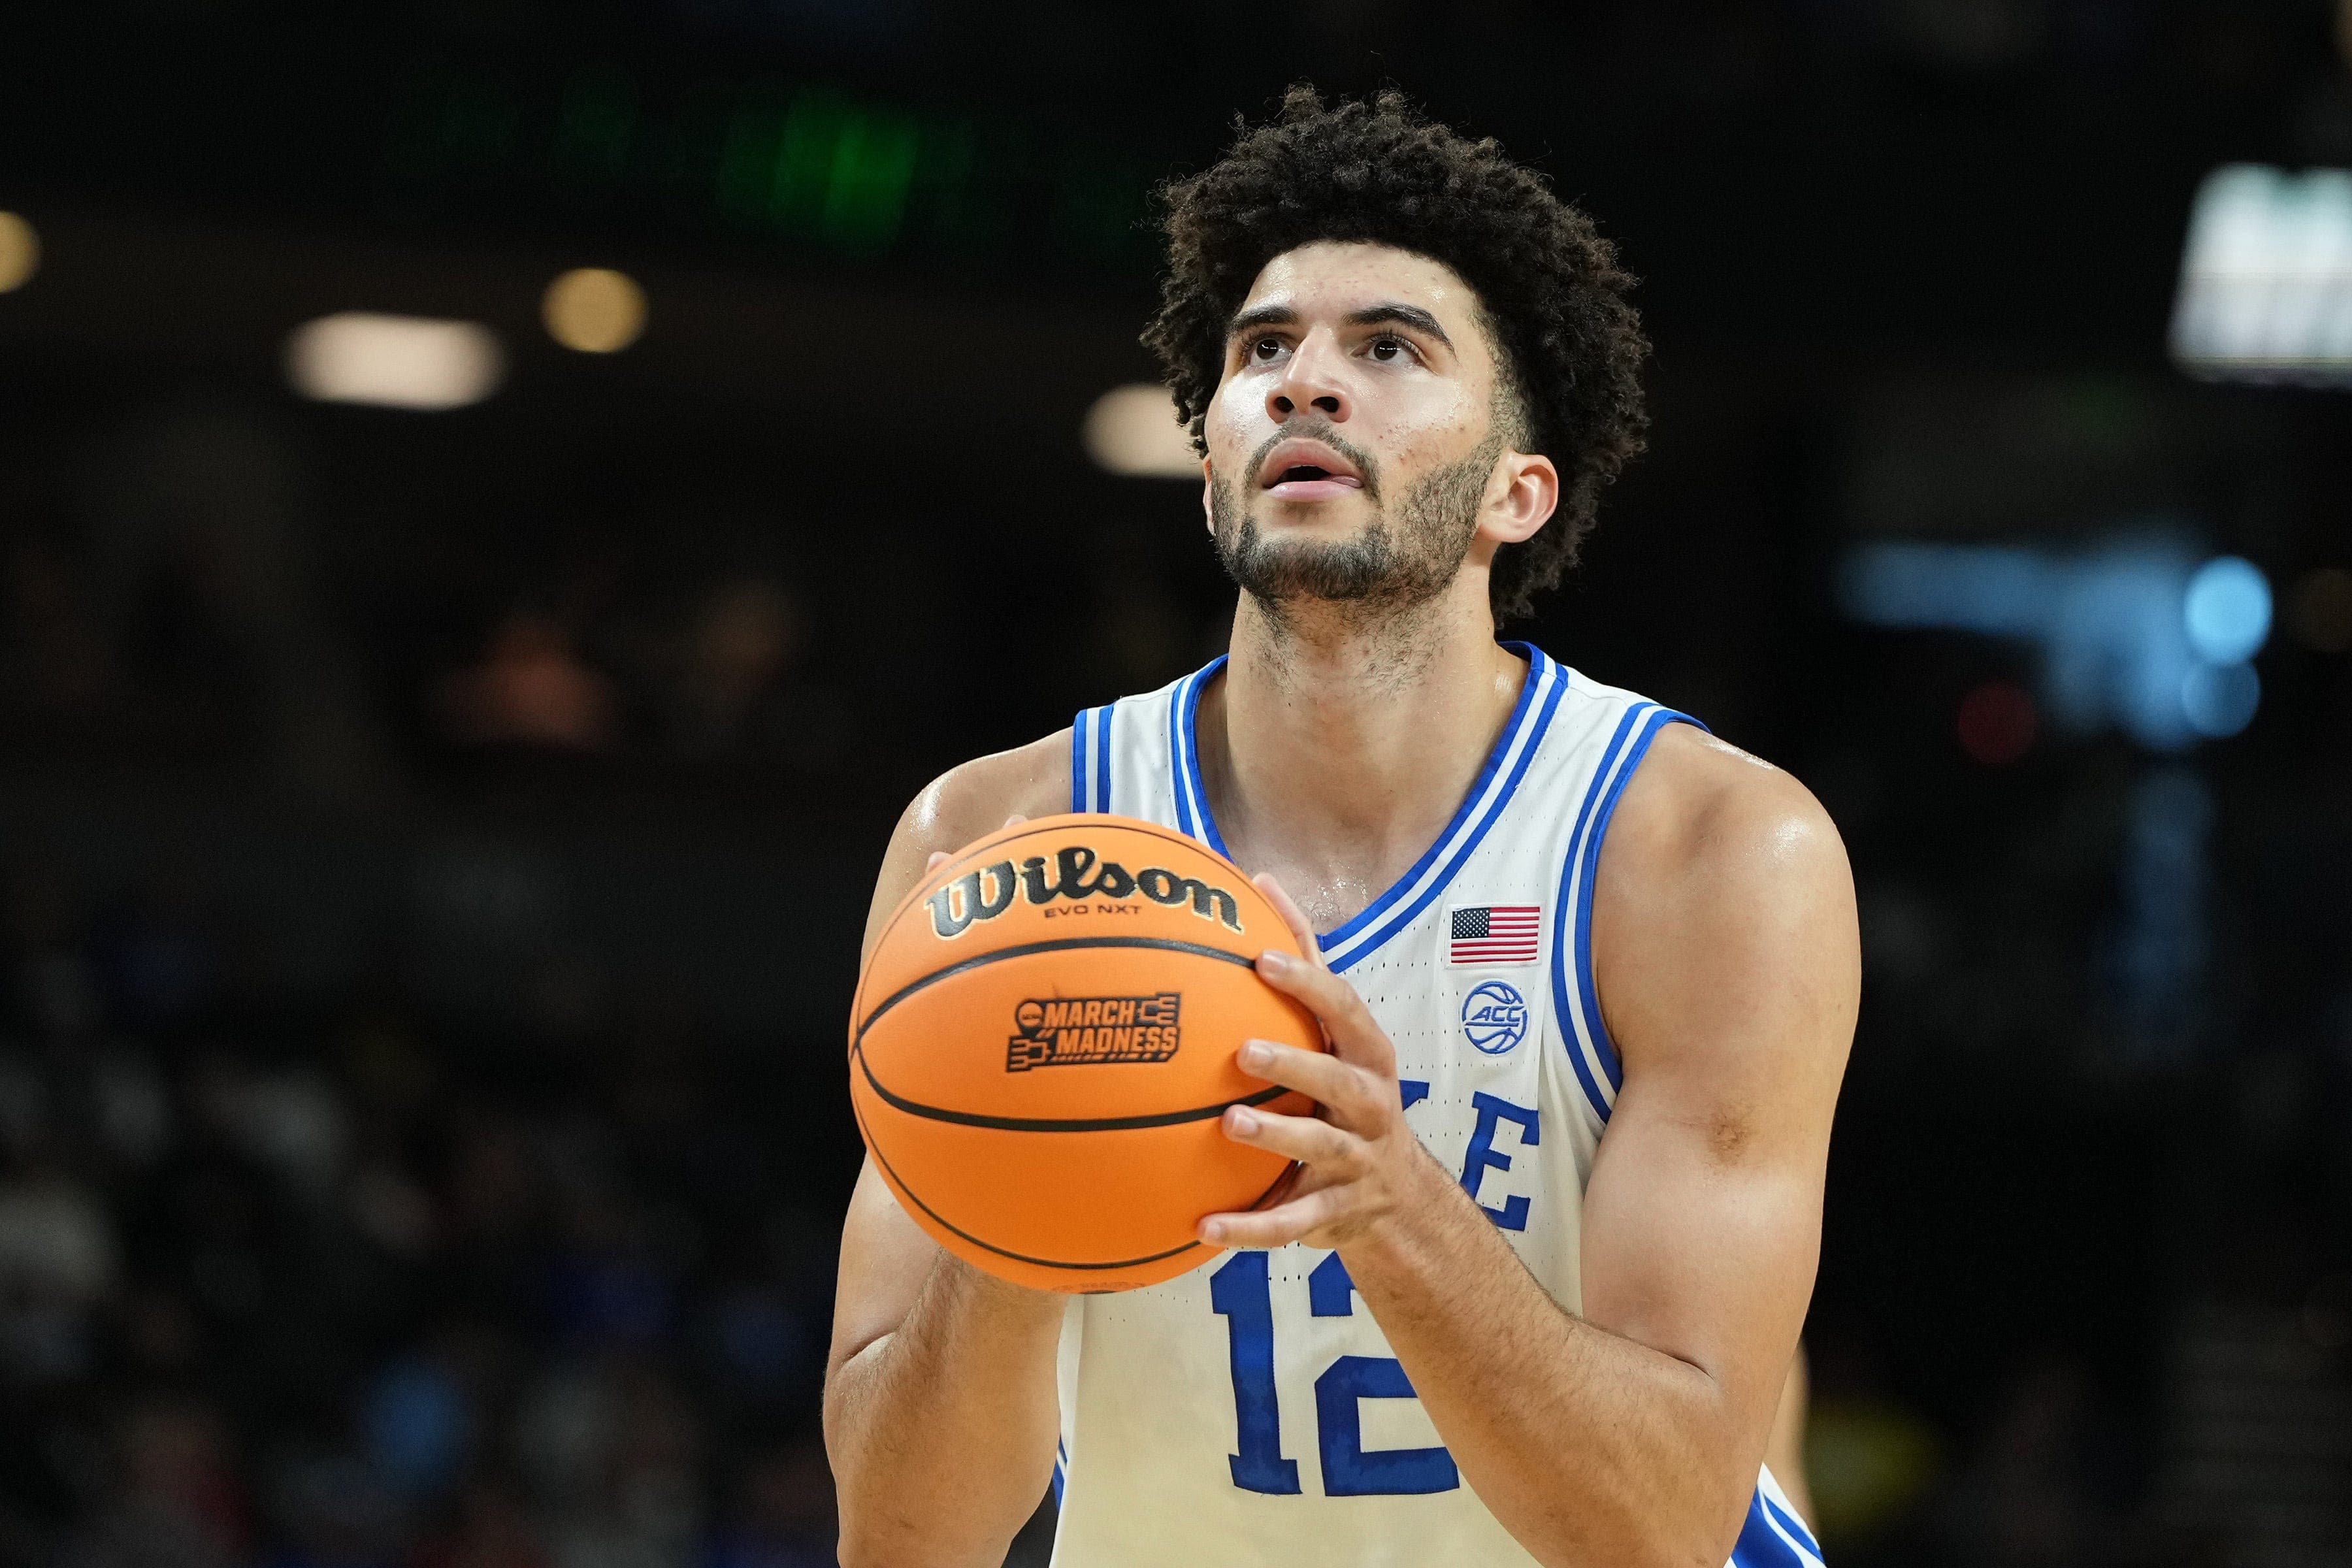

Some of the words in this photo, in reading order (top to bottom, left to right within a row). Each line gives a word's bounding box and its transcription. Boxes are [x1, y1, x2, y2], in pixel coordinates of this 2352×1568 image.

[924, 846, 1245, 939] Wilson
[1044, 904, 1088, 918] EVO
[1098, 904, 1142, 915] NXT
[1045, 1000, 1135, 1027] MARCH
[1471, 1006, 1525, 1022] ACC
[1056, 1026, 1177, 1054] MADNESS
[1210, 1250, 1460, 1497] 12
